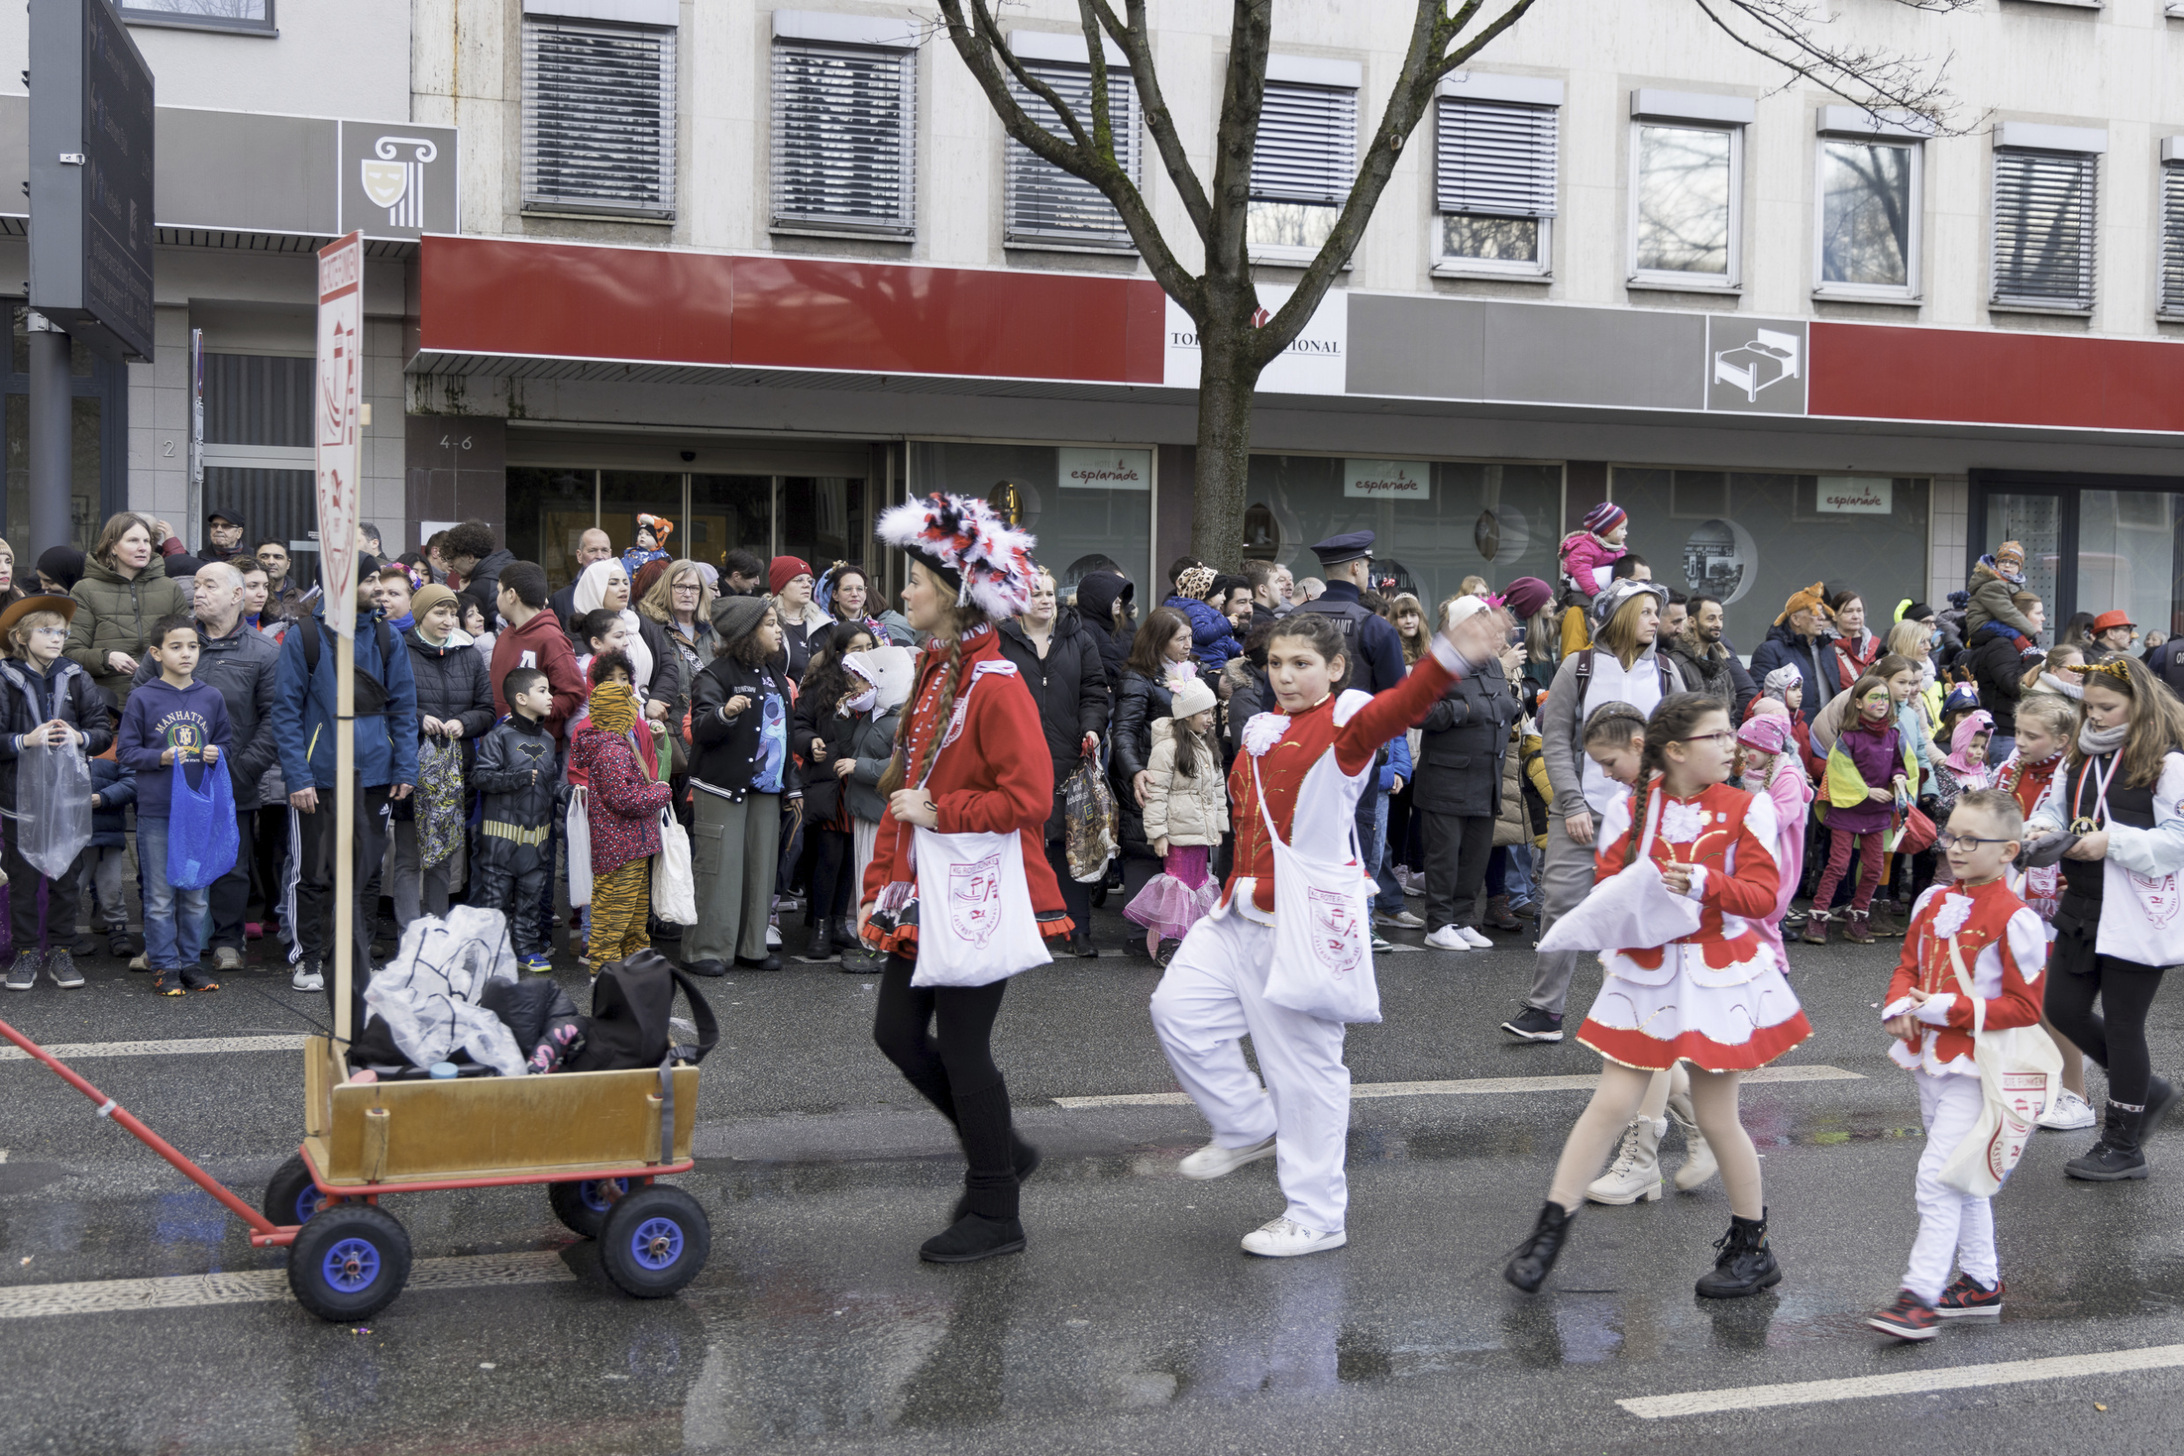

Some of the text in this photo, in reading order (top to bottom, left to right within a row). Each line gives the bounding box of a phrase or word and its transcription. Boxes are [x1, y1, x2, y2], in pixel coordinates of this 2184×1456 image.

[163, 440, 175, 458] 2
[1071, 469, 1139, 485] esplanade
[1355, 479, 1418, 494] esplanade
[1826, 494, 1882, 509] esplanade
